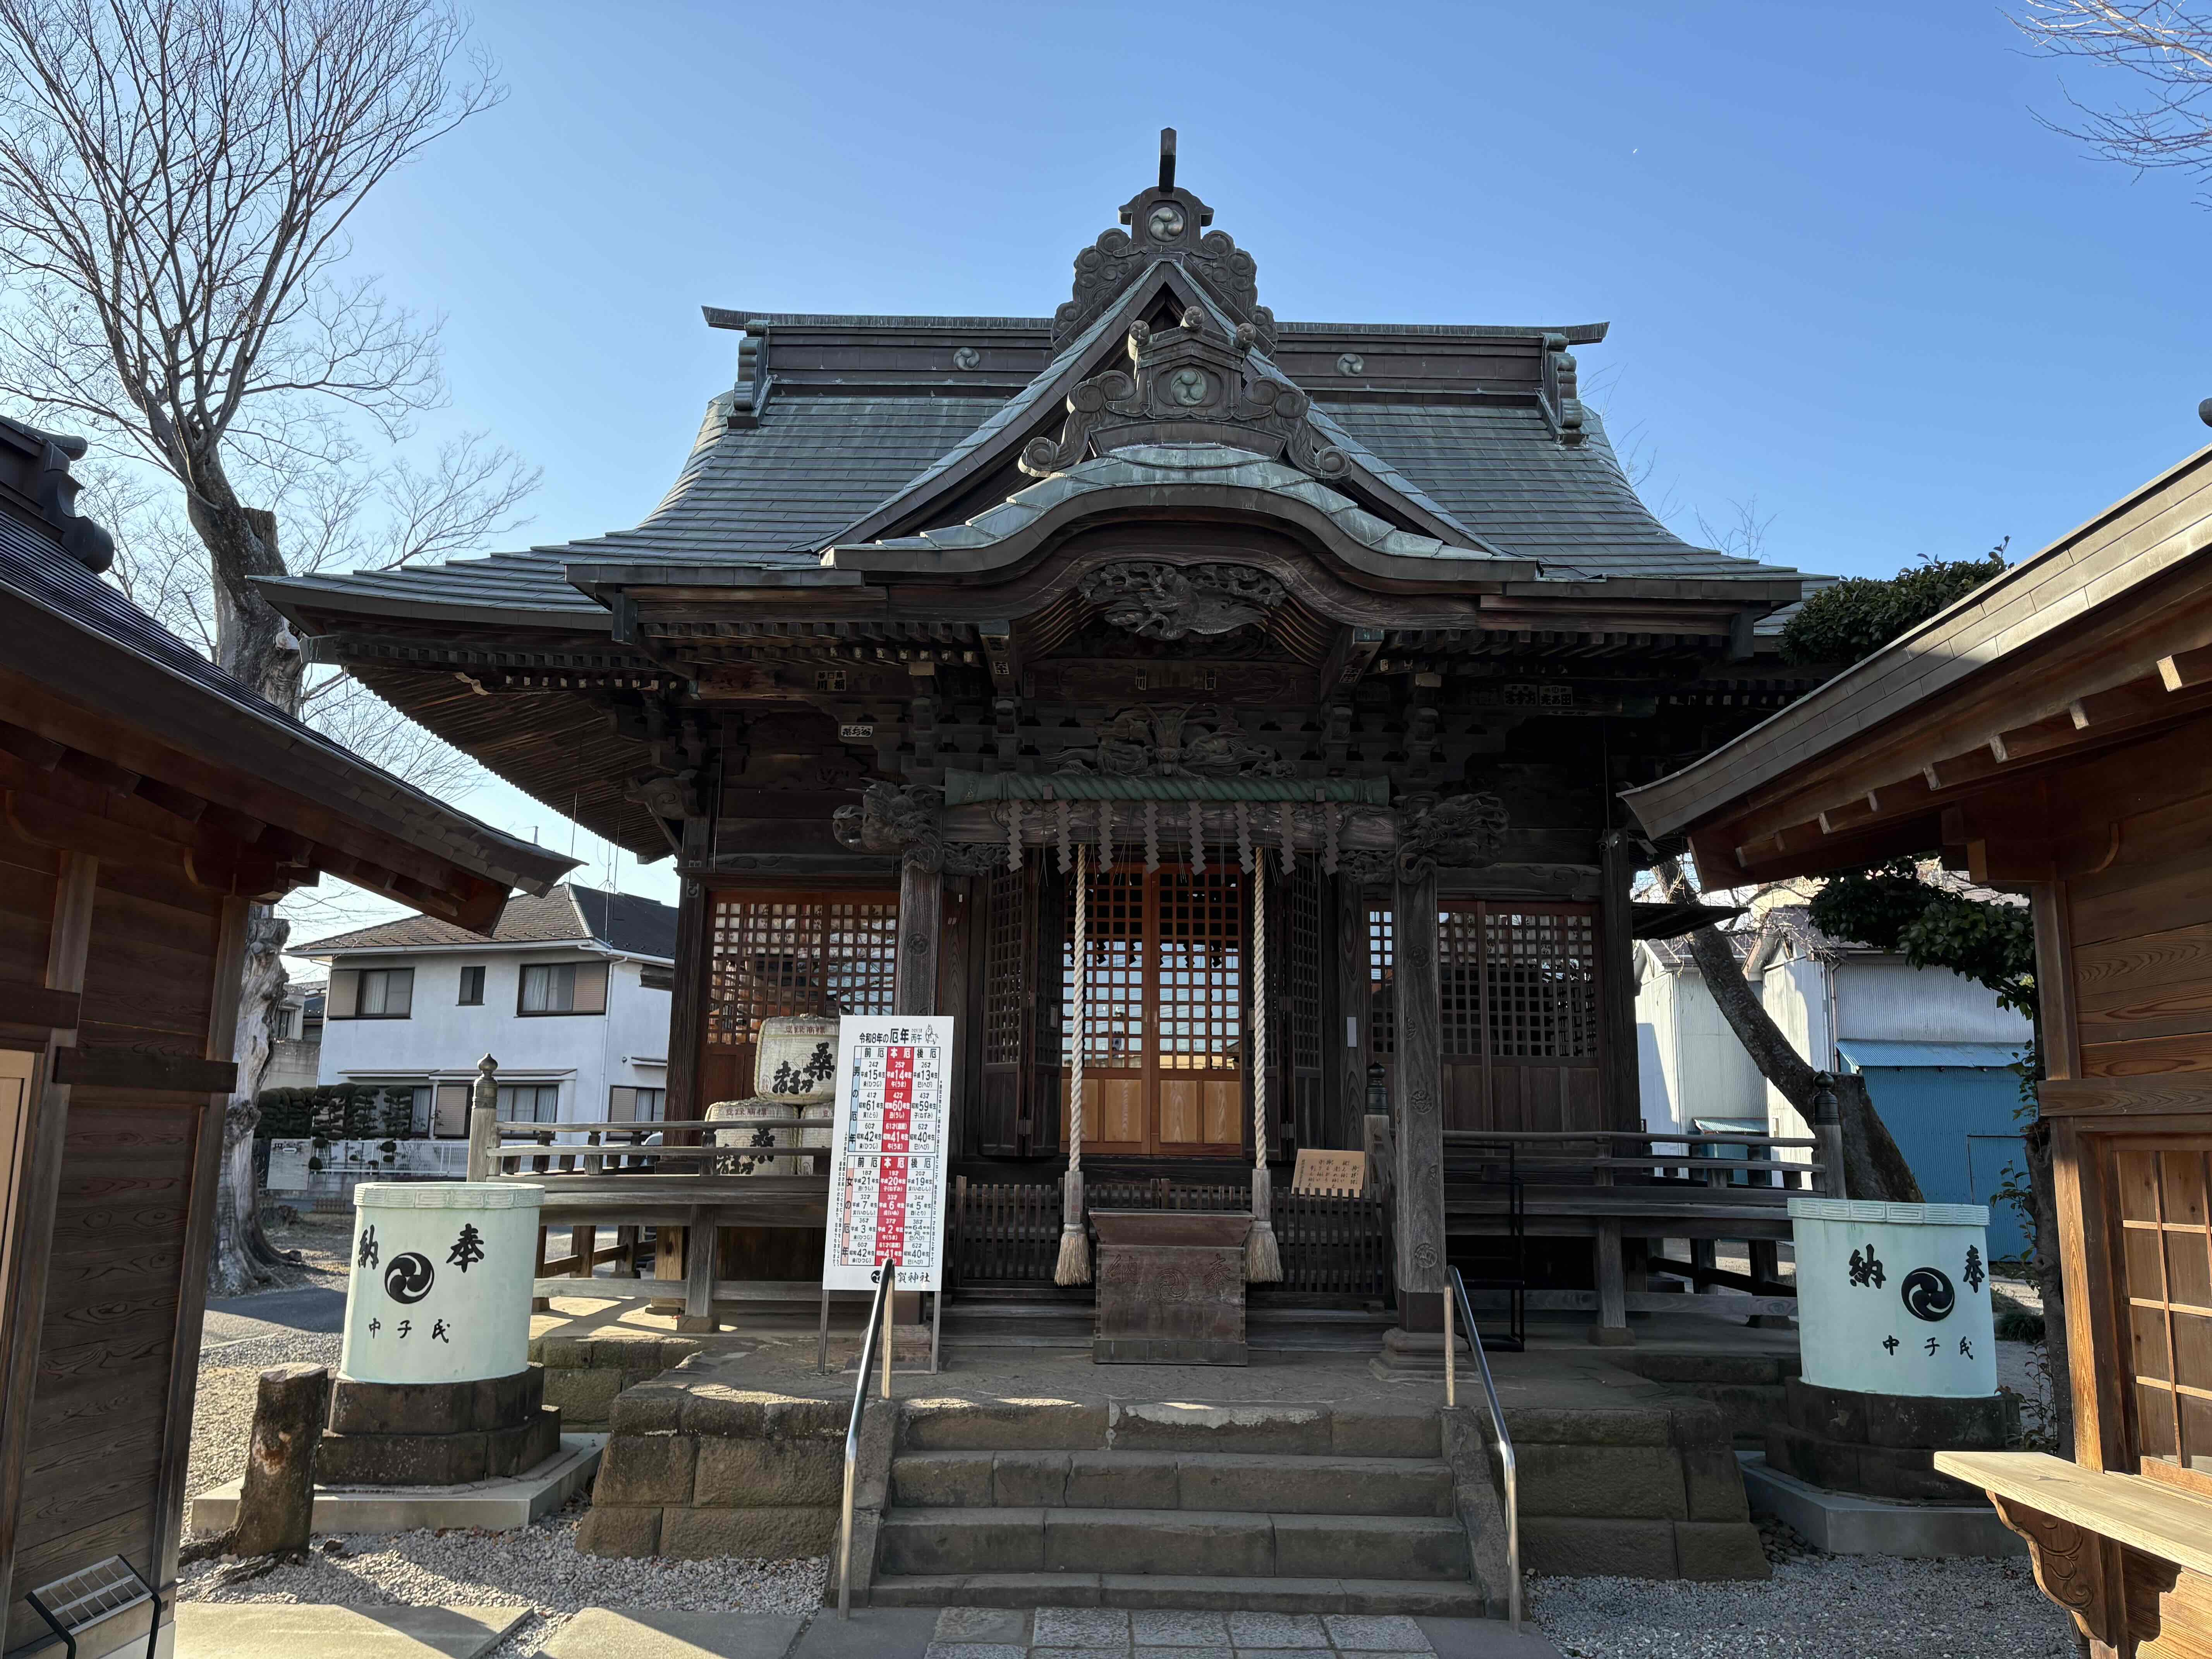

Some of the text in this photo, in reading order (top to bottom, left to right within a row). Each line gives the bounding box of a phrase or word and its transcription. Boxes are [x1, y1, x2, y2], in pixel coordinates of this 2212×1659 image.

[859, 1028, 922, 1044] 令和8年の厄年 丙午
[865, 1048, 884, 1058] 前厄
[890, 1047, 911, 1058] 本厄
[917, 1048, 937, 1058] 後厄
[861, 1069, 885, 1080] 平成15年生
[914, 1070, 938, 1080] 平成13年生
[849, 1066, 860, 1144] 男の厄年
[859, 1100, 883, 1111] 昭和61年生
[911, 1101, 936, 1111] 昭和59年生
[857, 1131, 881, 1142] 昭和42年生
[909, 1132, 934, 1142] 昭和40年生
[858, 1157, 878, 1168] 前厄
[884, 1157, 904, 1168] 本厄
[912, 1158, 931, 1168] 後厄
[854, 1176, 879, 1185] 平成21年生
[908, 1177, 933, 1185] 平成19年生
[842, 1177, 853, 1257] 女の厄年
[357, 1223, 484, 1273] 奉 納
[850, 1249, 875, 1257] 昭和42年生
[904, 1250, 929, 1258] 昭和40年生
[1849, 1243, 1985, 1293] 奉 納
[894, 1272, 930, 1283] 賀神社
